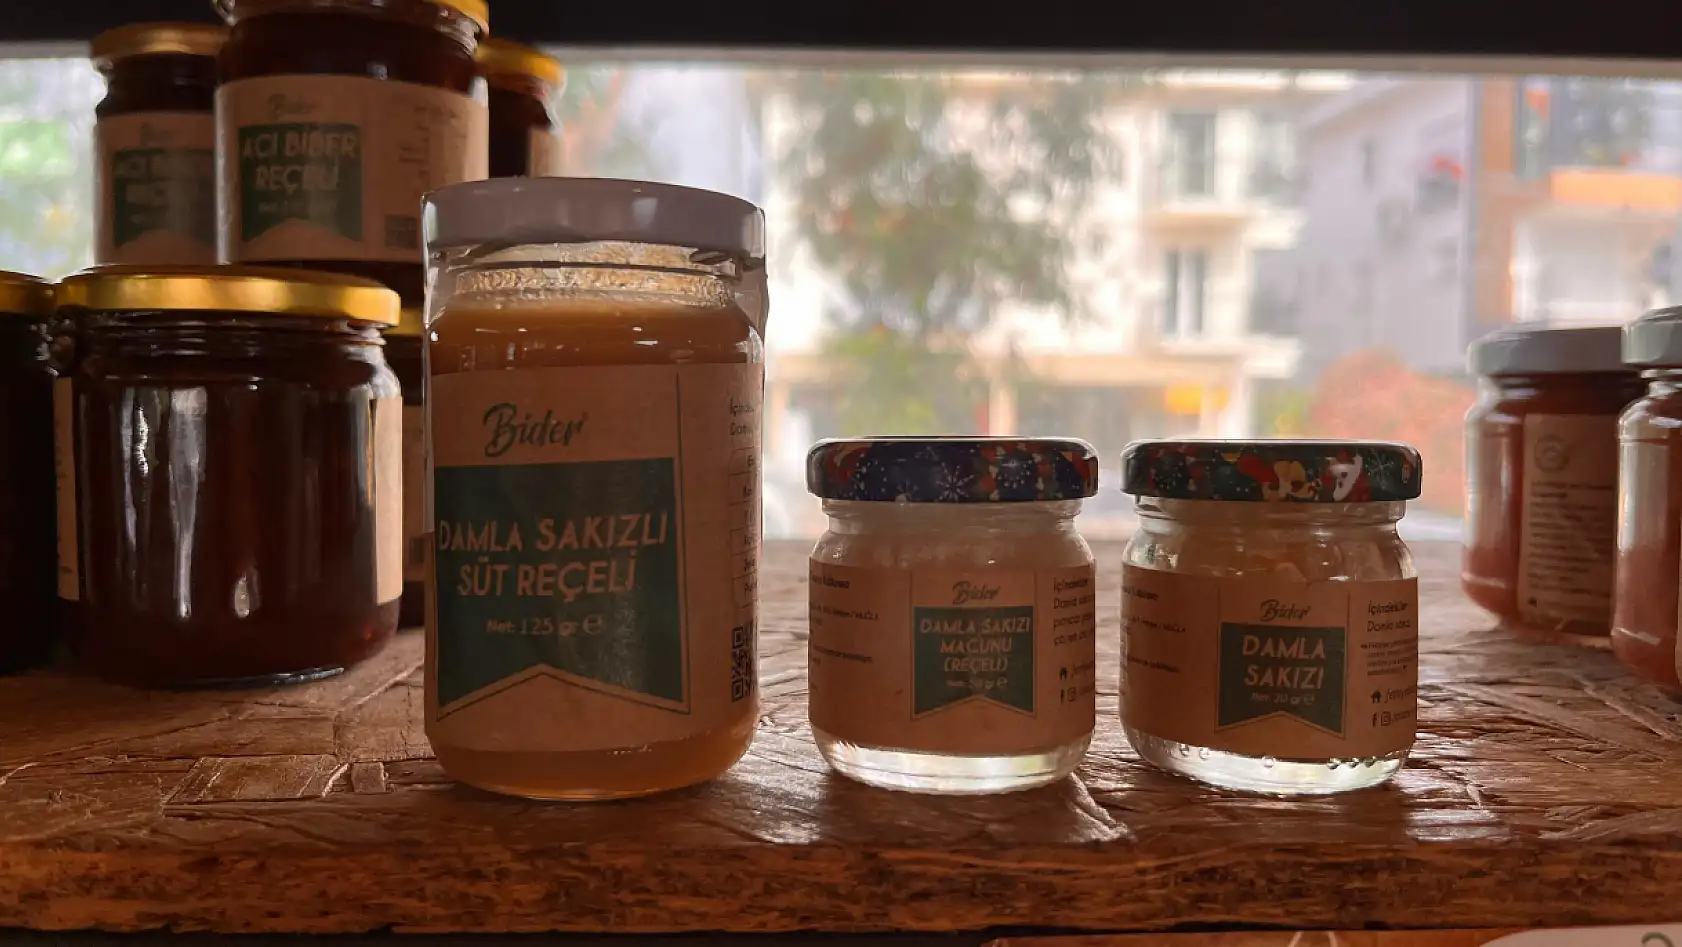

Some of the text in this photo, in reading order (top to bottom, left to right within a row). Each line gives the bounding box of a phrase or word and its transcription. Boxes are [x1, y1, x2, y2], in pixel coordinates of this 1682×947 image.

[483, 402, 590, 457] Bider
[438, 509, 669, 552] DAMLA SAKIZLI
[457, 550, 638, 603] SÜT REÇELİ
[519, 618, 554, 636] 125
[920, 616, 1031, 634] DAMLA SAKIZI
[1241, 634, 1326, 660] DAMLA
[1243, 664, 1325, 690] SAKIZI
